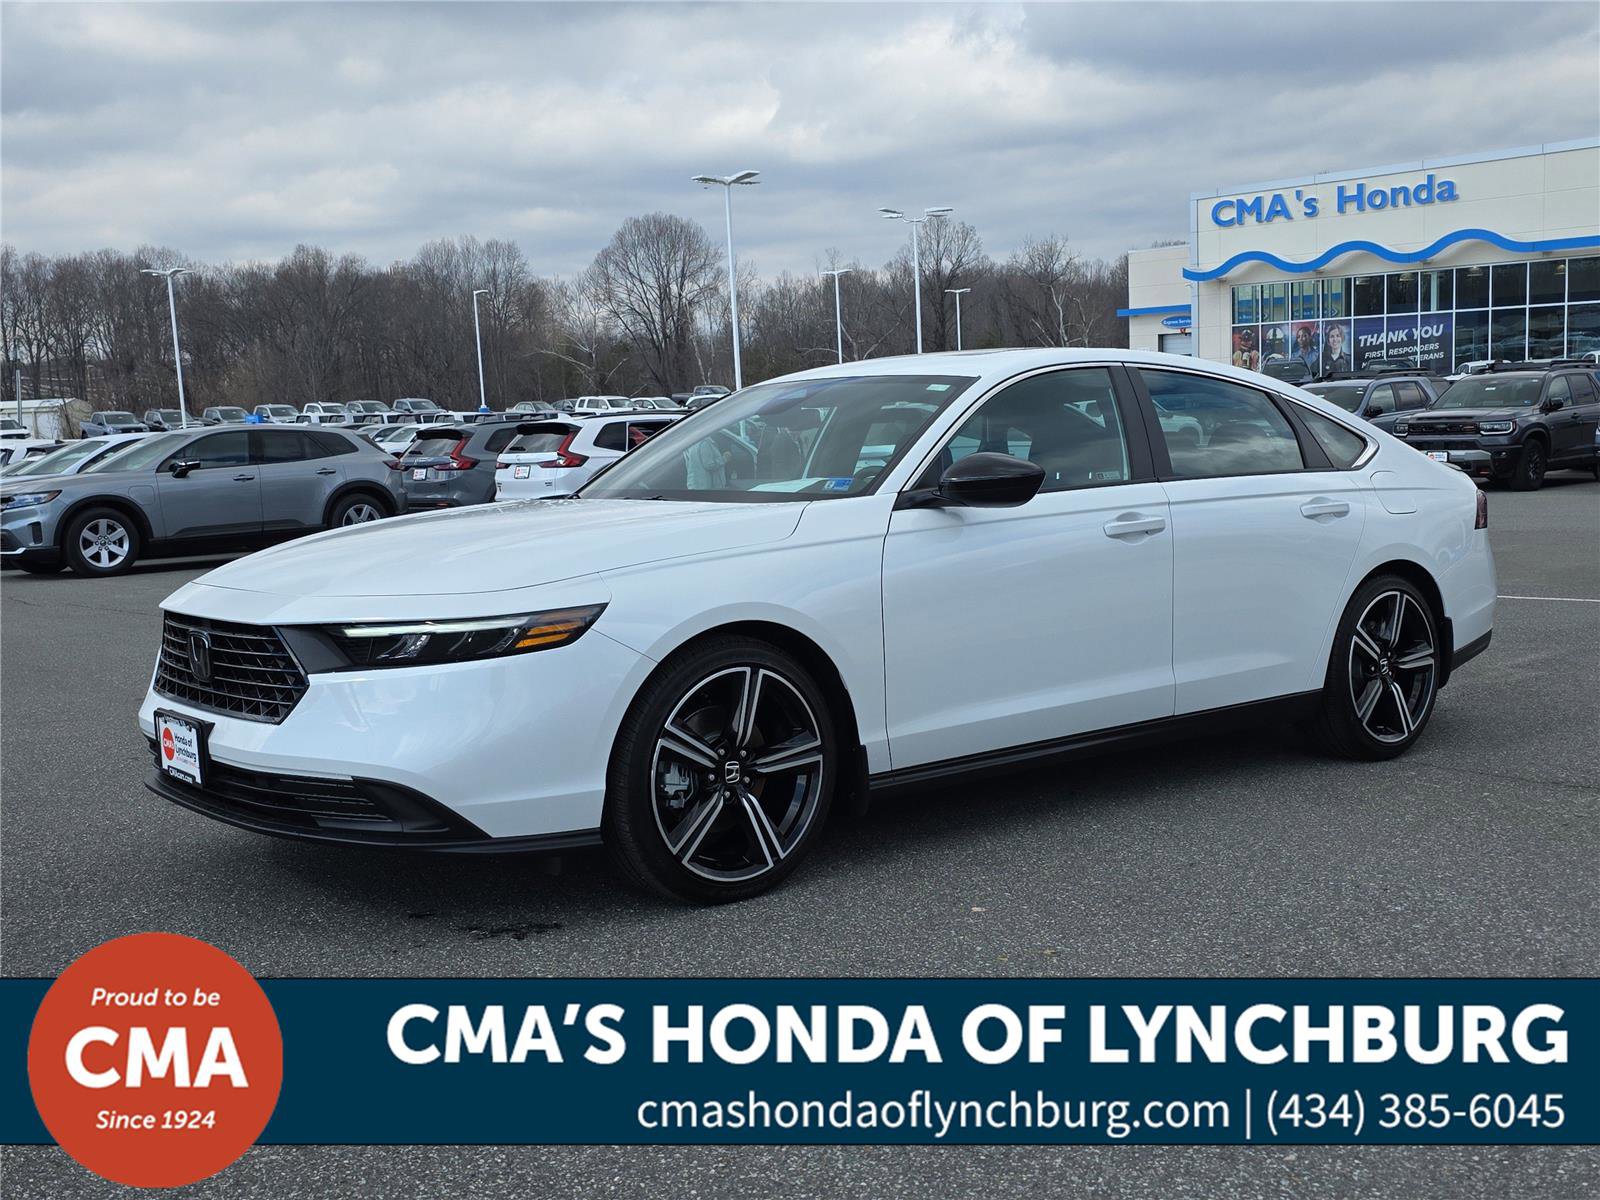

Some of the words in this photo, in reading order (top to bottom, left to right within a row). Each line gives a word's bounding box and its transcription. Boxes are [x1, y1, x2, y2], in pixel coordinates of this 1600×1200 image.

[1212, 190, 1318, 226] CMA's
[1337, 174, 1458, 213] Honda
[1358, 329, 1409, 347] THANK
[1412, 324, 1443, 340] YOU
[1364, 351, 1386, 360] FIRST
[1389, 343, 1440, 356] RESPONDERS
